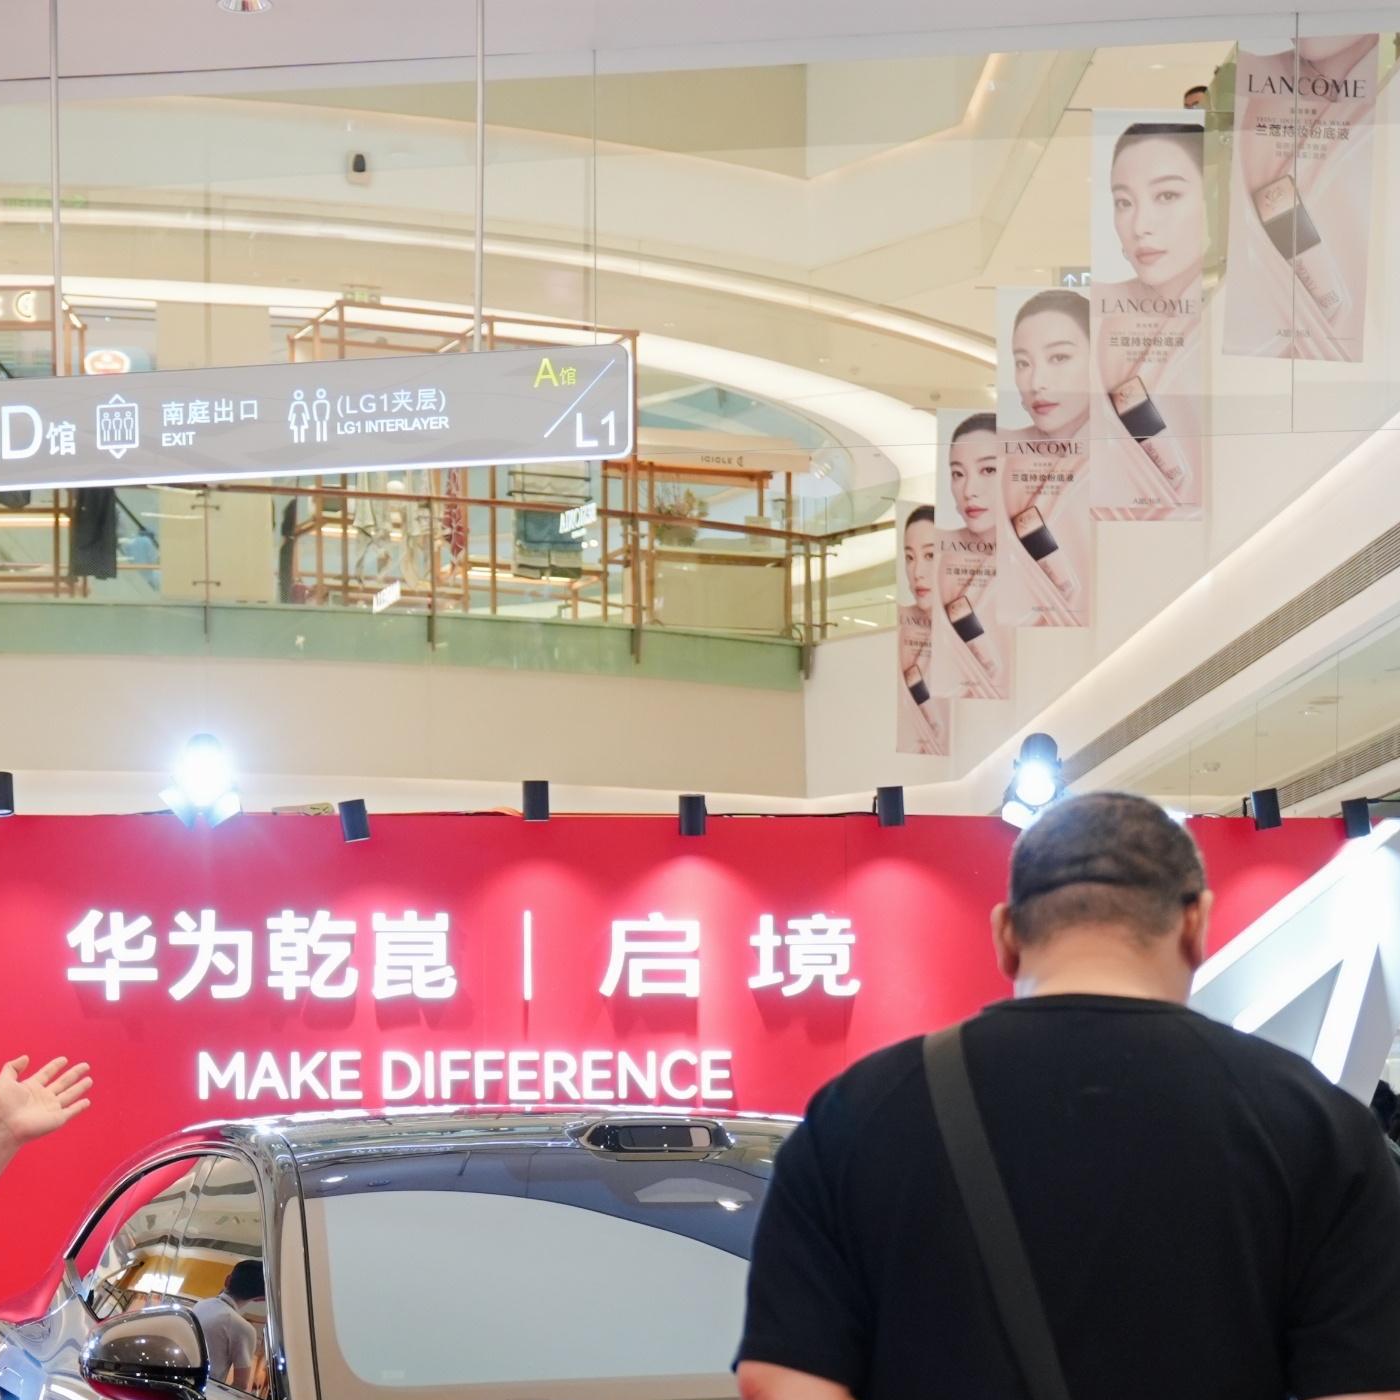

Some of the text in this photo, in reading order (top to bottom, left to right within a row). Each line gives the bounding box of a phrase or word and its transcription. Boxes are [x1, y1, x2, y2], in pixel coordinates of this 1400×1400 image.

[533, 357, 577, 389] A馆
[161, 400, 259, 427] 南庭出口
[336, 387, 448, 419] (LG1夹层)
[1, 405, 77, 460] D馆
[161, 431, 196, 447] EXIT
[337, 416, 450, 435] LG1 INTERLAYER
[574, 410, 616, 449] L1
[66, 908, 861, 1002] 华为乾崑 启境
[197, 1050, 734, 1101] MAKE DIFFERENCE
